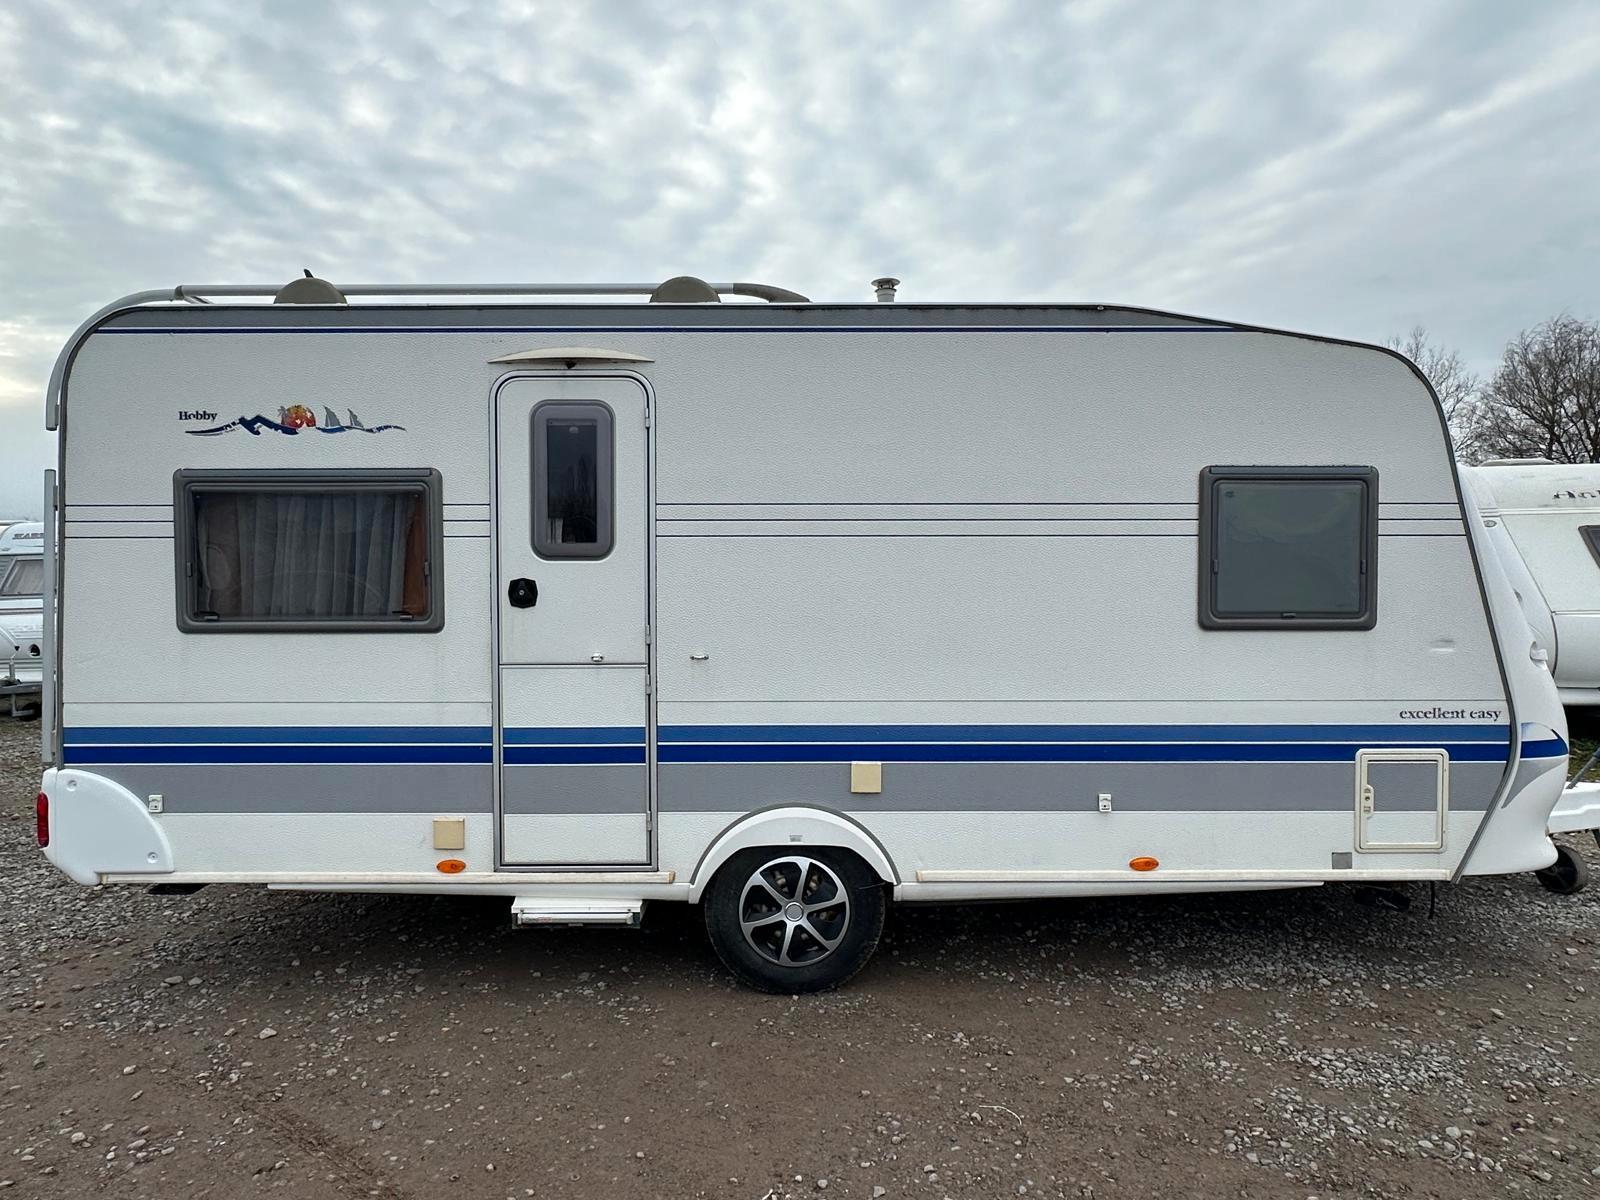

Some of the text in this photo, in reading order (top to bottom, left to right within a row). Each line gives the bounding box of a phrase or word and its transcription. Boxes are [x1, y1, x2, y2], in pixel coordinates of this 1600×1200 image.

[178, 410, 218, 423] Hobby
[1399, 707, 1502, 722] excellent easy
